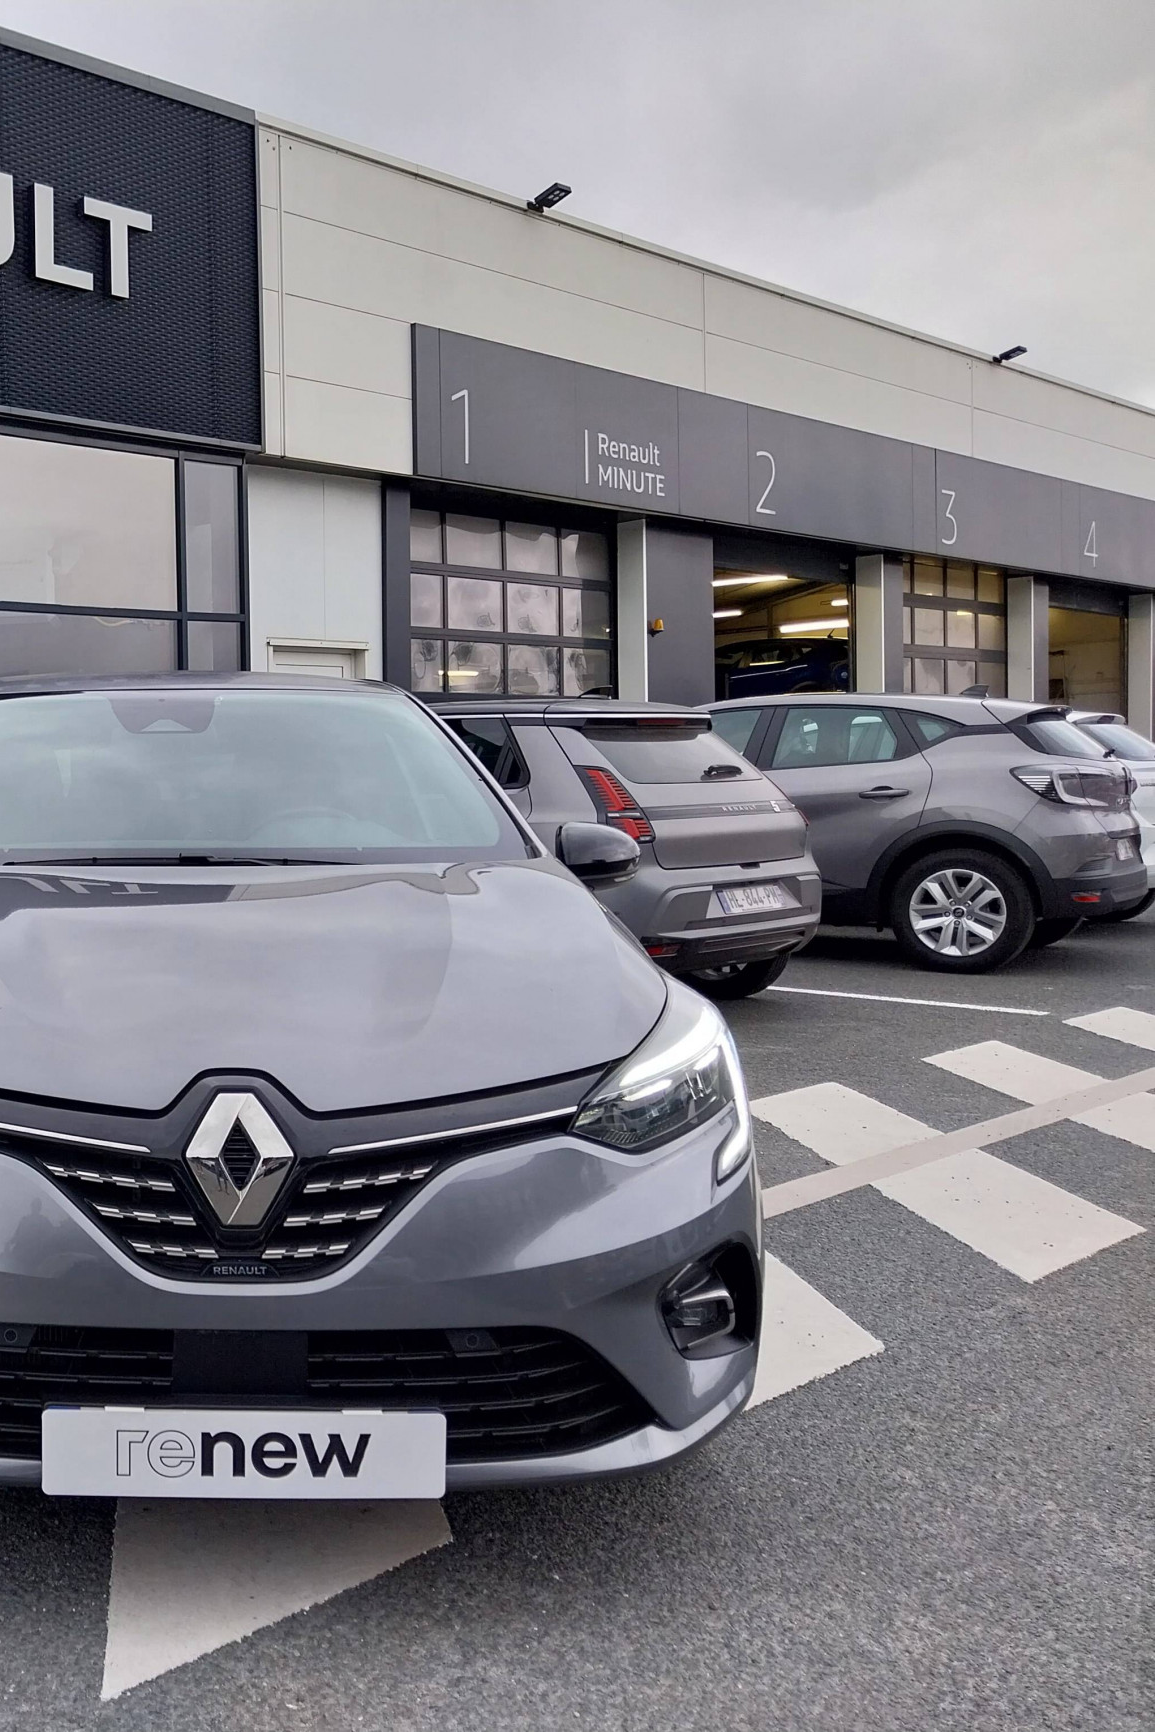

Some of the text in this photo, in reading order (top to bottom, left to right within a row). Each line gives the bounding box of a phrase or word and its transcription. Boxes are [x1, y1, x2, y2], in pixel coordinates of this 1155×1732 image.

[451, 389, 470, 465] 1
[597, 432, 661, 467] Renault
[597, 463, 666, 497] MINUTE
[755, 450, 777, 515] 2
[941, 489, 958, 545] 3
[1083, 520, 1099, 568] 4
[769, 800, 781, 813] 5
[212, 1265, 268, 1276] RENAULT
[115, 1429, 372, 1479] renew
